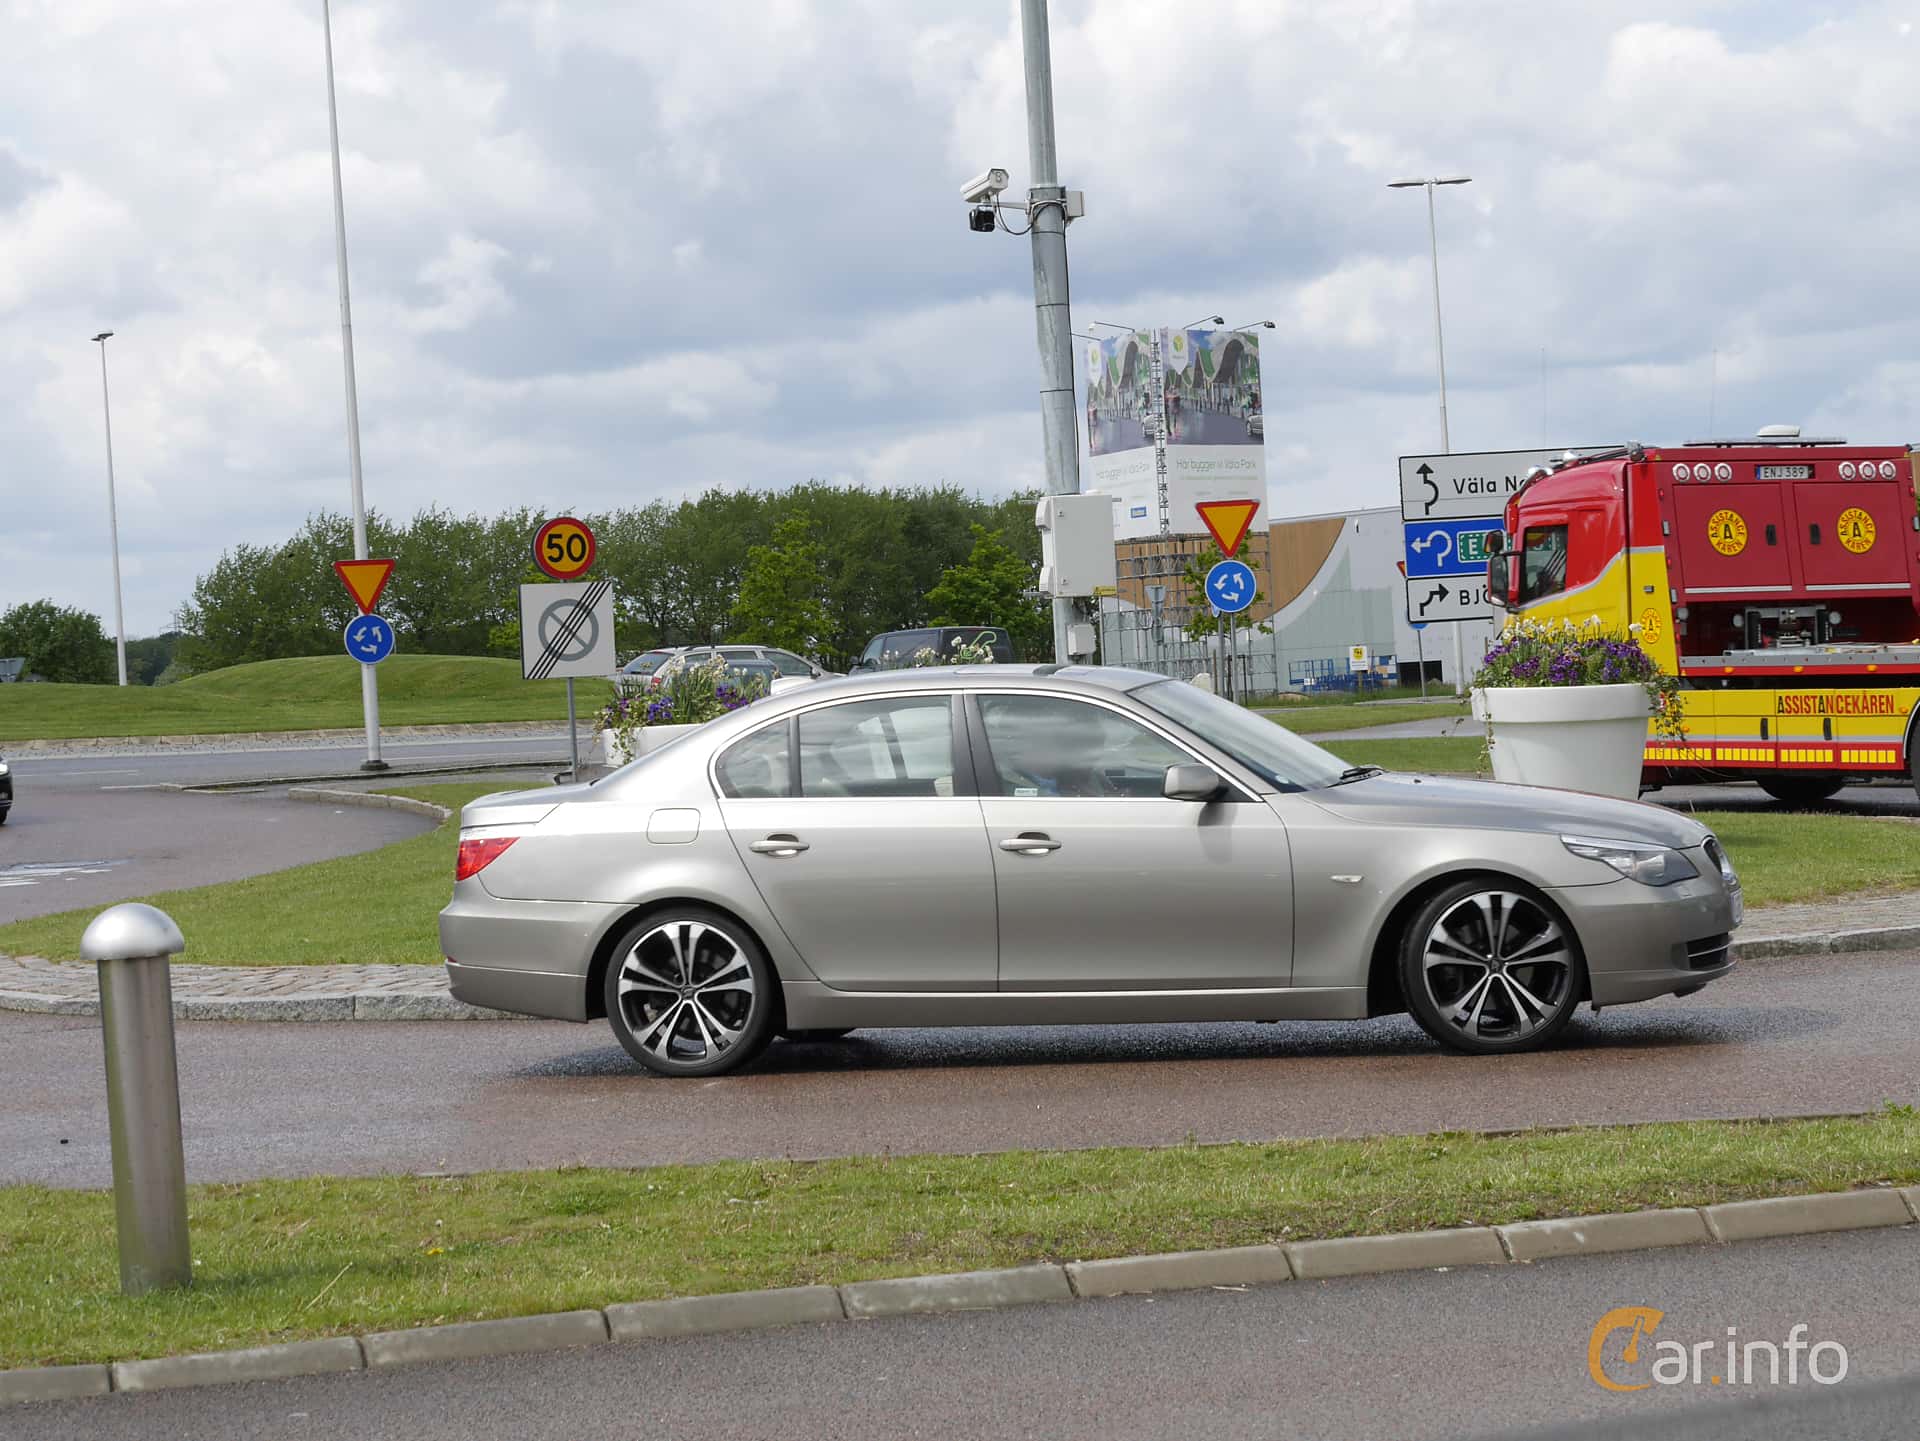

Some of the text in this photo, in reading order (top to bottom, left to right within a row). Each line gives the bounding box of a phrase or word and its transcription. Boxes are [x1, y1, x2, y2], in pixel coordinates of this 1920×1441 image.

[1763, 466, 1805, 478] ENJ 389
[1452, 475, 1525, 494] Väla N
[1711, 511, 1745, 538] ASSISTANCE
[1840, 510, 1874, 536] ASSISTANCE
[546, 533, 587, 563] 50
[1777, 691, 1895, 714] ASSISTANCEKÅREN
